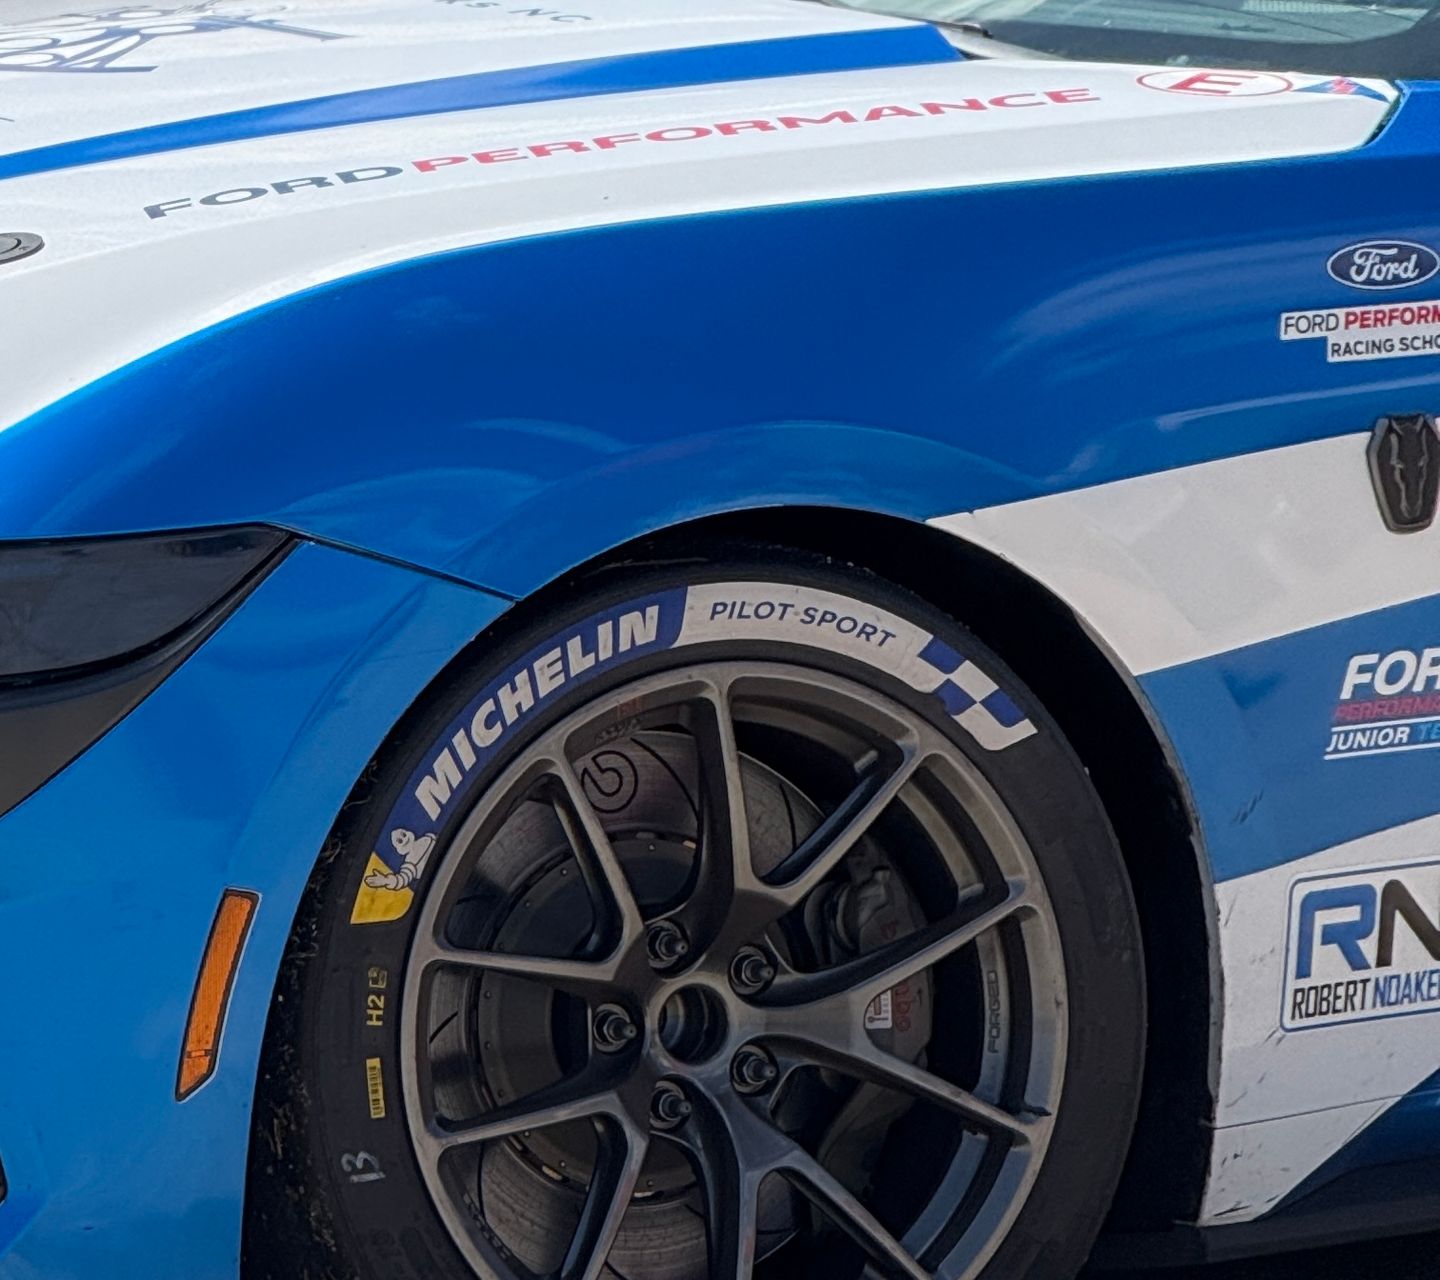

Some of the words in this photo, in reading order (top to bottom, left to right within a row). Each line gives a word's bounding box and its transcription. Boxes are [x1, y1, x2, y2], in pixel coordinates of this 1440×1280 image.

[509, 7, 593, 24] NC
[1350, 247, 1420, 282] Ford
[1284, 313, 1339, 336] FORD
[1331, 338, 1395, 357] RACING
[413, 605, 661, 822] MICHELIN
[709, 600, 796, 623] PILOT
[800, 606, 897, 648] SPORT
[1325, 726, 1411, 753] JUNIOR
[1372, 968, 1440, 1008] NOAKE
[365, 993, 386, 1027] H2
